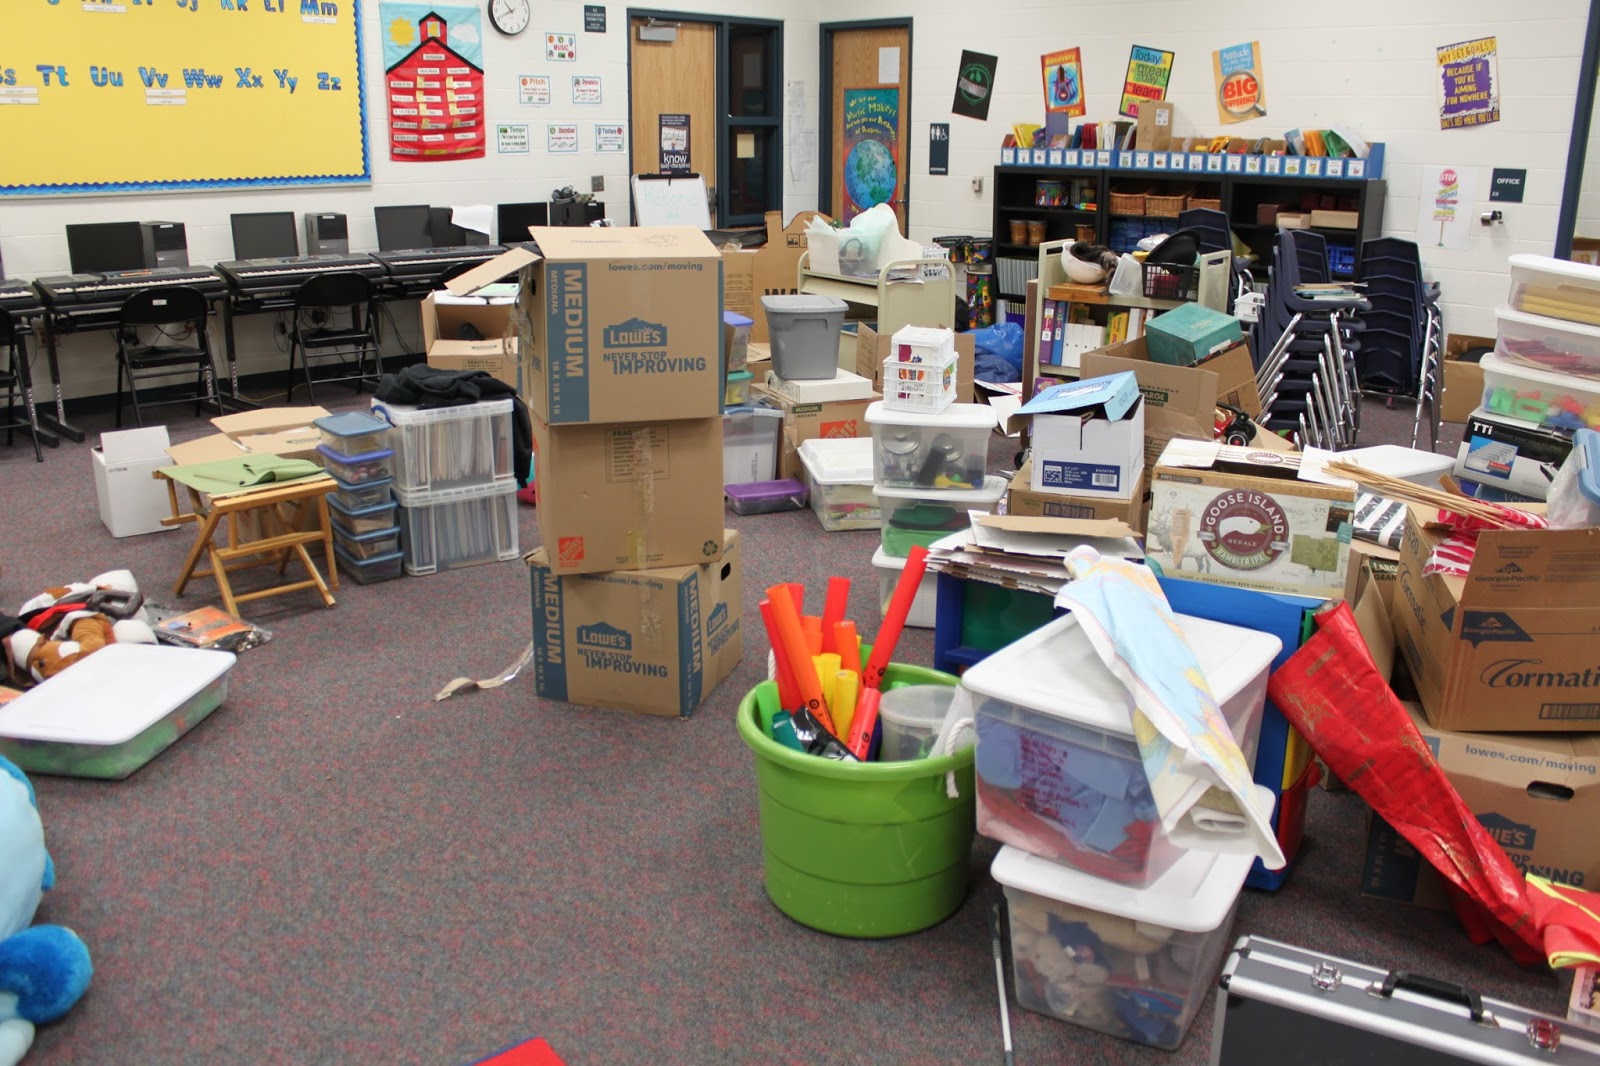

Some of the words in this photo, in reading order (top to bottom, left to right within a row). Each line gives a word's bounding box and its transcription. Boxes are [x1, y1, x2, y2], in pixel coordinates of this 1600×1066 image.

[300, 0, 338, 16] Mm
[1134, 49, 1162, 66] Today
[1223, 48, 1250, 59] Attitude
[1438, 53, 1451, 63] WHY
[1452, 49, 1464, 59] SET
[1466, 40, 1494, 56] GOALS?
[1137, 64, 1168, 79] great
[1446, 64, 1474, 77] BECAUSE
[1475, 63, 1483, 72] IF
[36, 64, 70, 87] Tt
[90, 66, 124, 87] Uu
[138, 67, 168, 88] Vv
[182, 68, 223, 88] Ww
[235, 67, 264, 88] Xx
[274, 69, 298, 94] Yy
[317, 72, 341, 91] Zz
[582, 79, 599, 87] Dynamics
[1141, 74, 1158, 86] day
[1454, 74, 1476, 86] YOU'RE
[1133, 83, 1162, 100] learn
[1223, 76, 1258, 100] BIG
[1454, 83, 1477, 95] AIMING
[1446, 96, 1458, 106] FOR
[1459, 91, 1489, 104] NOWHERE
[846, 107, 866, 121] Music
[868, 102, 896, 117] Makers
[664, 153, 687, 165] know
[1440, 173, 1457, 182] STOP
[608, 261, 704, 272] lowes.com/moving
[550, 270, 559, 315] MEDIANA
[564, 269, 584, 378] MEDIUM
[610, 329, 662, 345] LOWE'S
[603, 352, 637, 362] NEVER
[640, 351, 667, 361] STOP
[613, 357, 707, 375] IMPROVING
[1143, 391, 1166, 401] ARGE
[1473, 421, 1493, 435] TTi
[1206, 492, 1244, 526] GOOSE
[1248, 493, 1284, 534] ISLAND
[1217, 549, 1251, 566] RAMBLER
[1251, 554, 1265, 565] IPA
[1373, 562, 1399, 572] LARG
[544, 572, 562, 665] MEDIUM
[689, 578, 701, 674] MEDIUM
[582, 628, 626, 648] LOWE'S
[577, 648, 606, 660] NEVER
[609, 651, 632, 662] STOP
[585, 654, 668, 679] IMPROVING
[1465, 744, 1597, 775] lowes.com/moving
